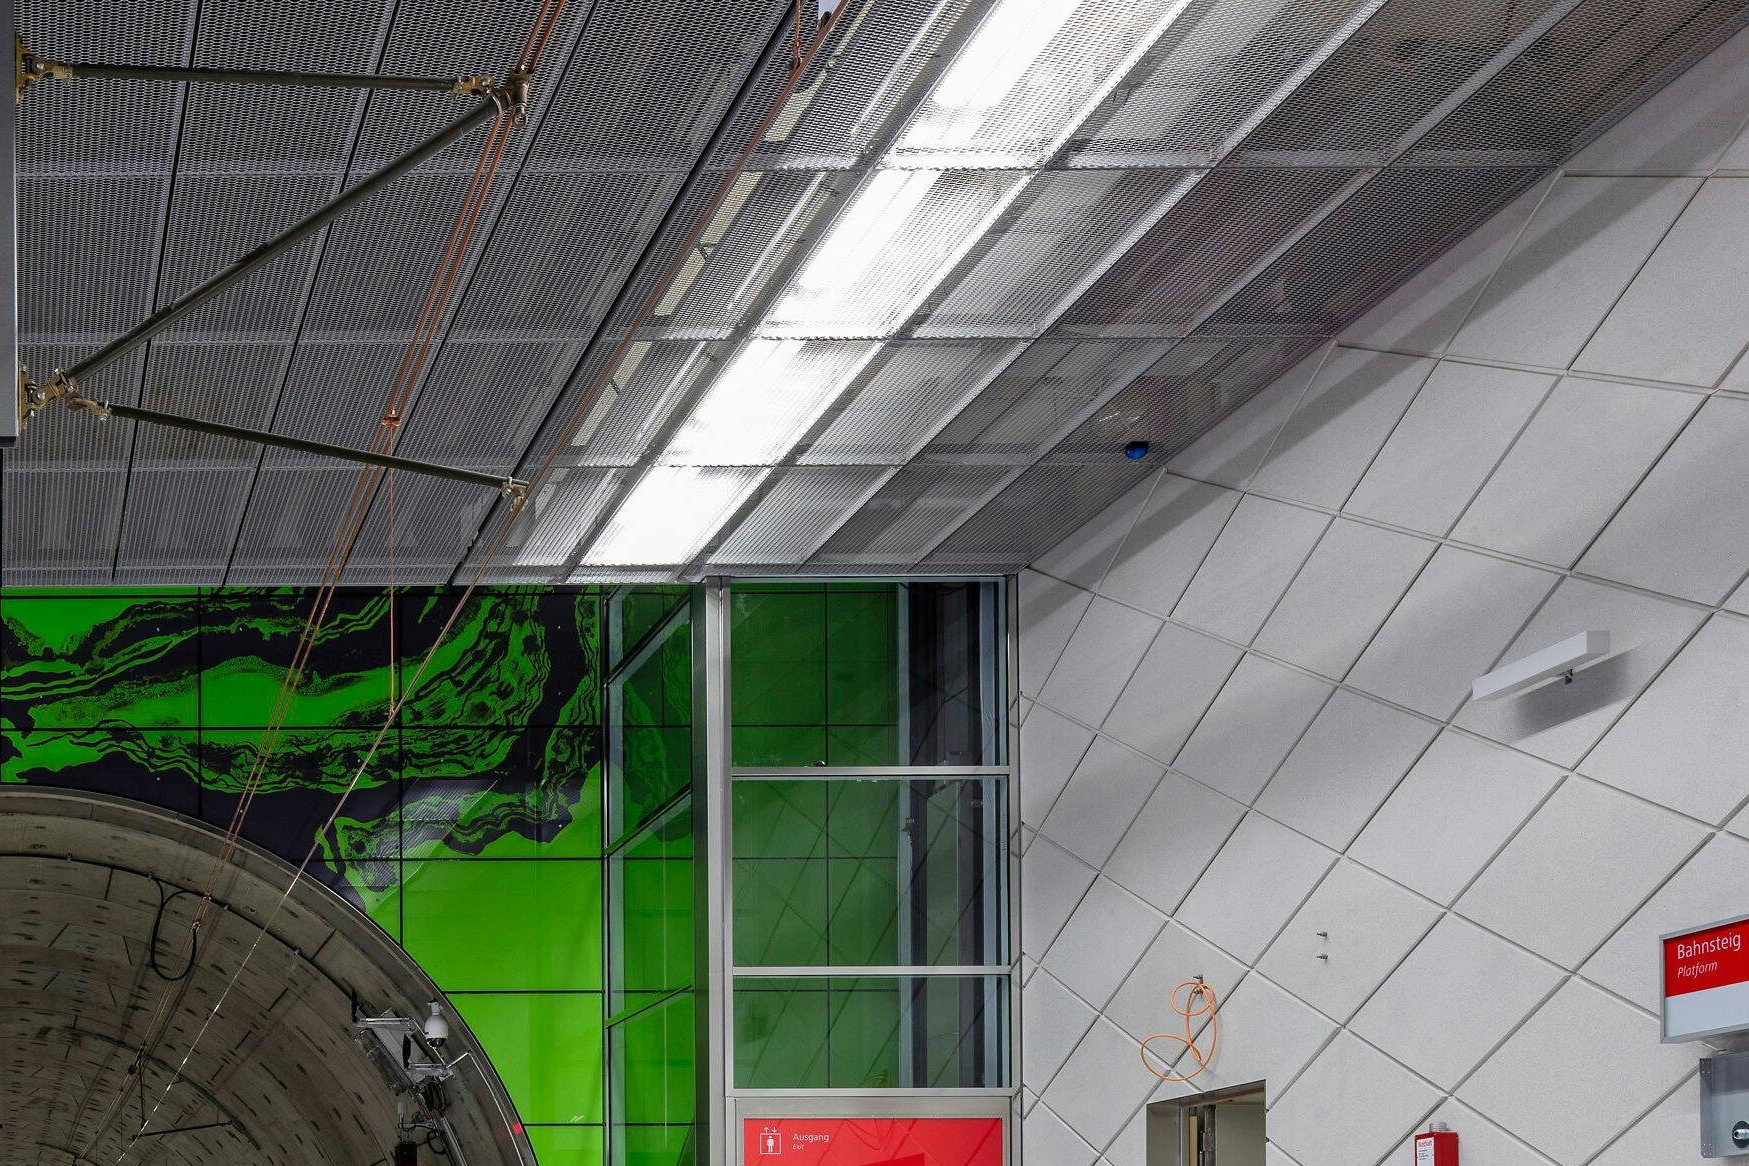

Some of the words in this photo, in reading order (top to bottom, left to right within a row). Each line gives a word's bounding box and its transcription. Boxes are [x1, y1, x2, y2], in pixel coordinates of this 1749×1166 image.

[1677, 931, 1741, 960] Bahnsteig
[1677, 961, 1718, 978] Platform
[792, 1133, 829, 1143] Ausgang
